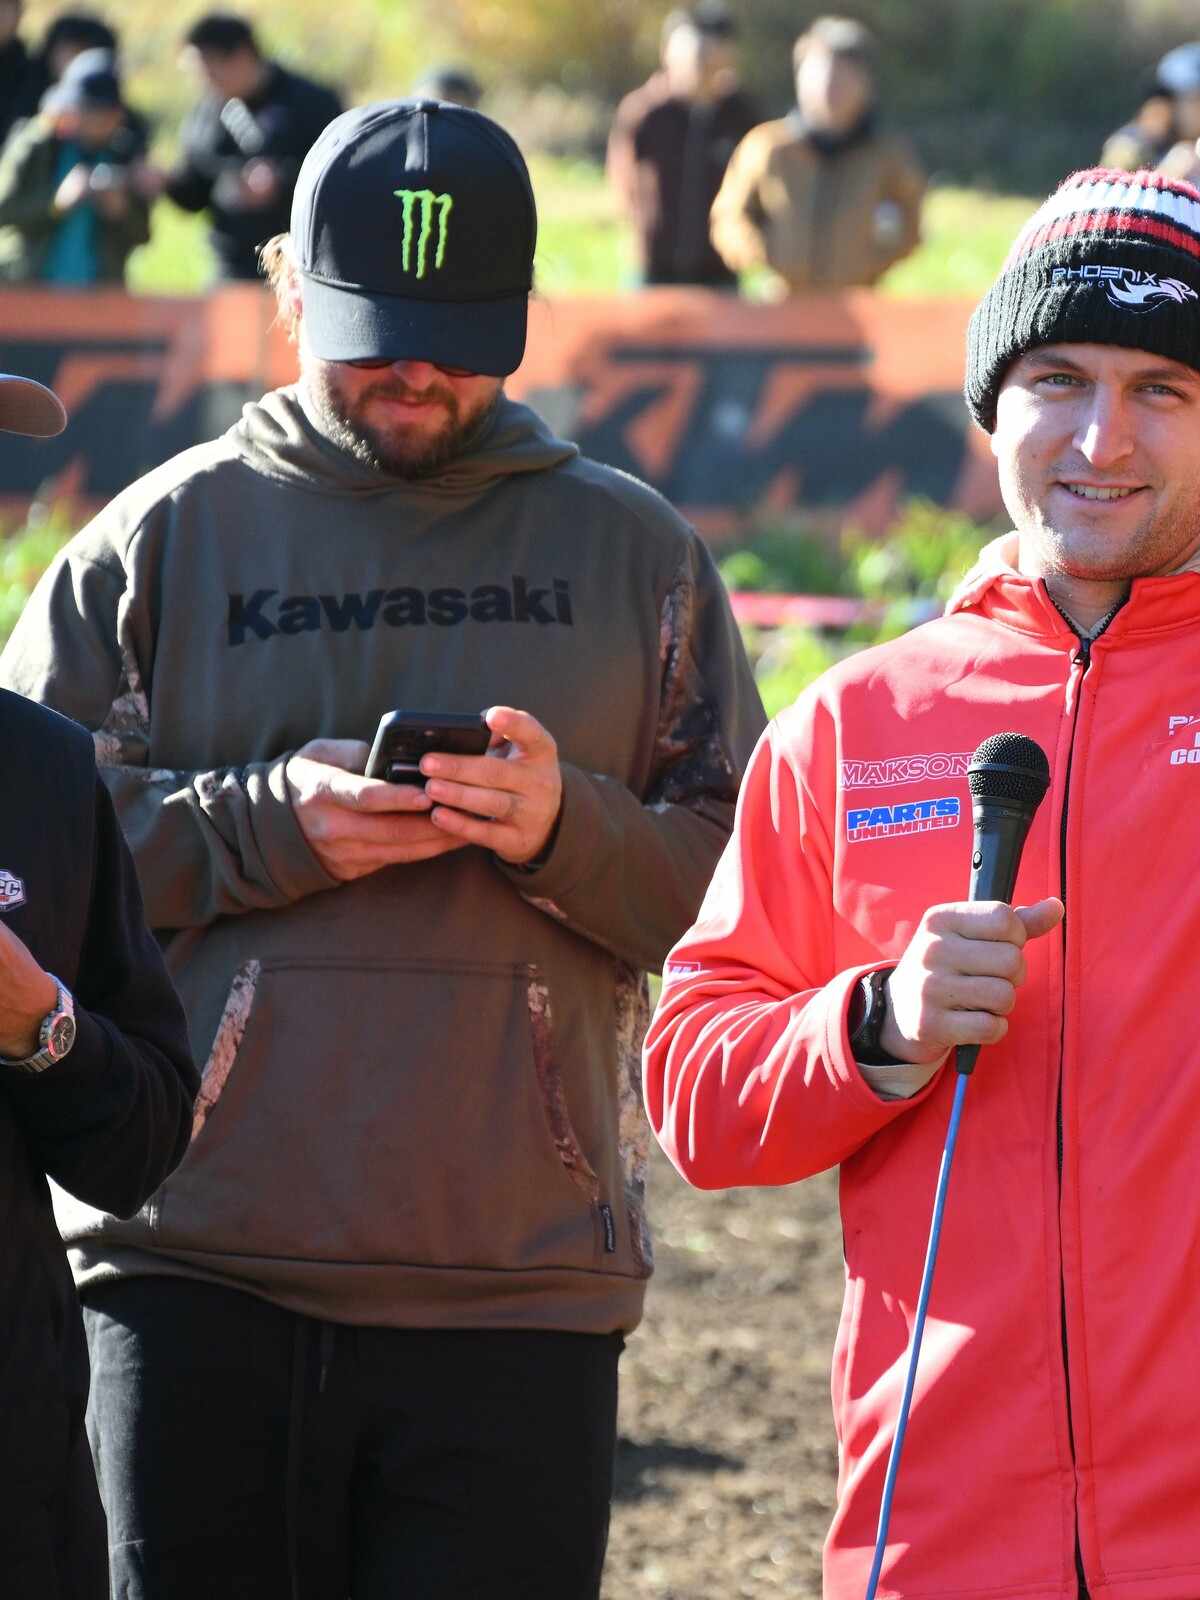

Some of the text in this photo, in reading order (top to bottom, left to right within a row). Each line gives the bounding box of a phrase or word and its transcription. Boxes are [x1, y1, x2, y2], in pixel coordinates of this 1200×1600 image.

[1051, 265, 1158, 286] PHOENIX
[228, 575, 573, 646] Kawasaki
[847, 797, 960, 830] PARTS
[848, 814, 960, 842] UNLIMITED
